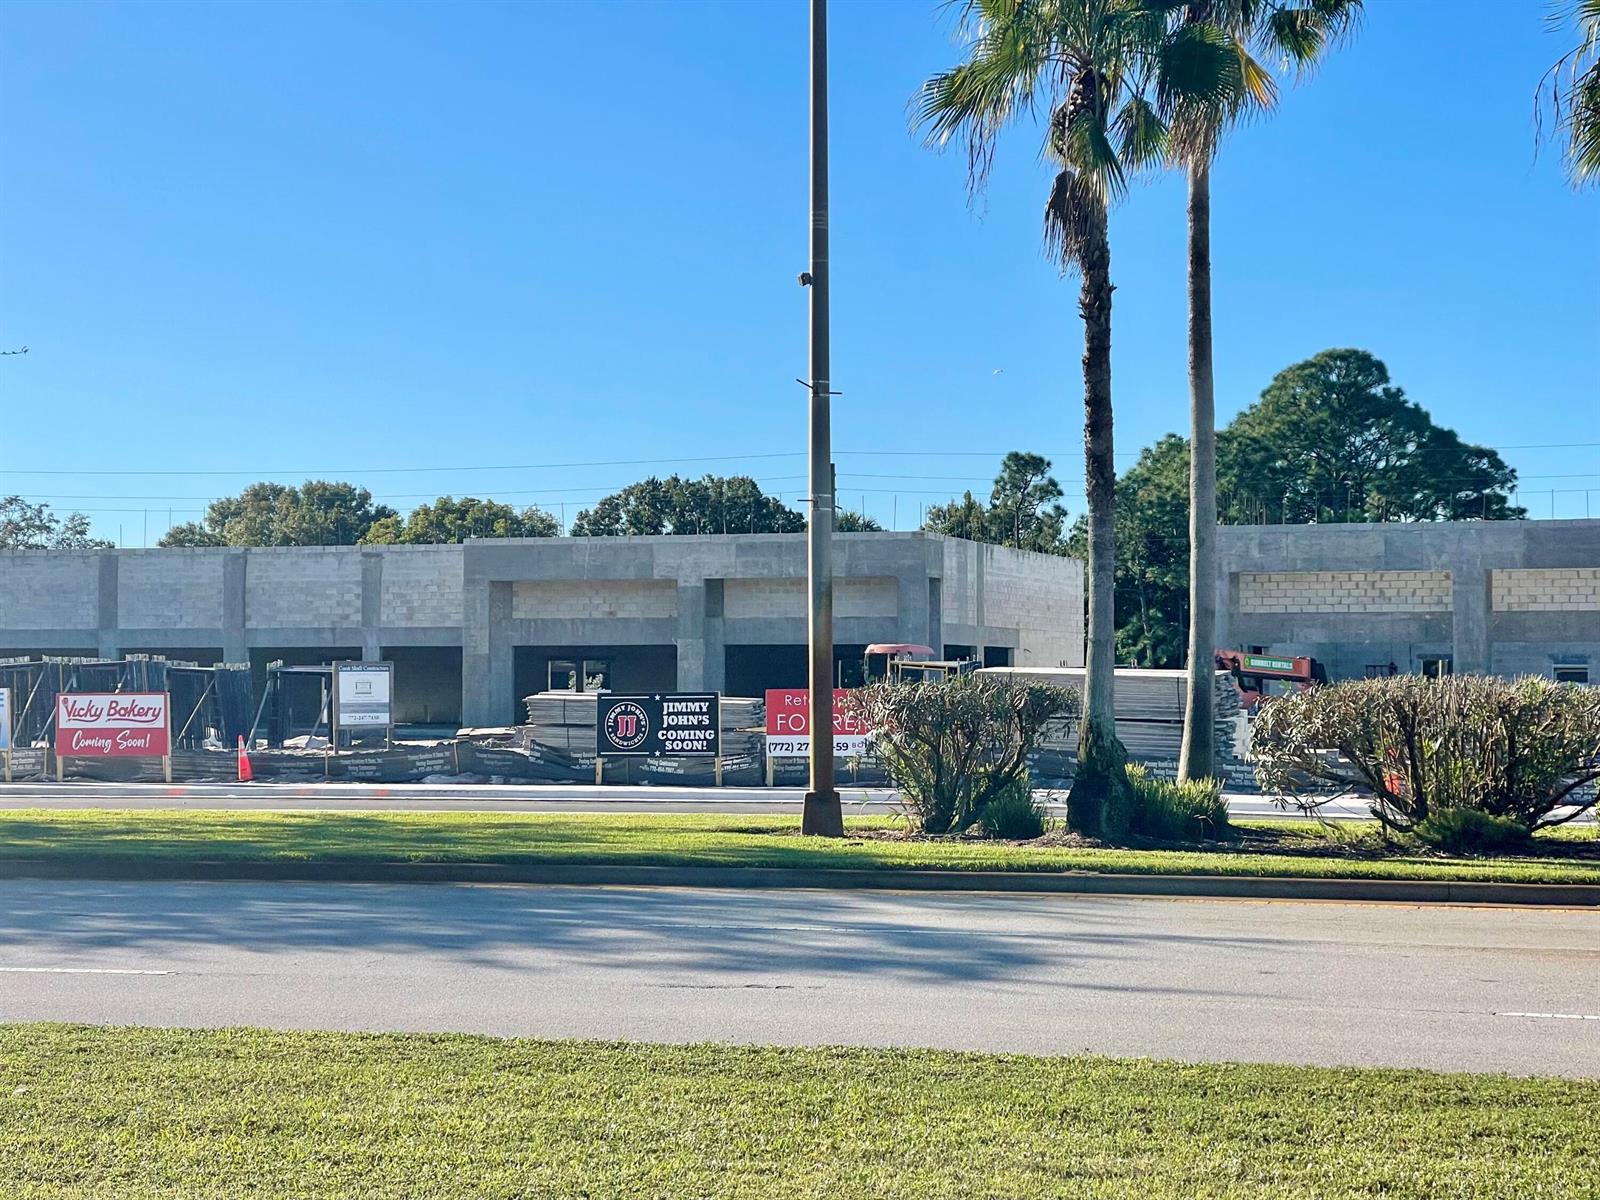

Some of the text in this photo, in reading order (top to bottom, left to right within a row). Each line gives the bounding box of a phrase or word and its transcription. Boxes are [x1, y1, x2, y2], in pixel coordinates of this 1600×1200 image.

[784, 694, 810, 706] Ret
[62, 698, 162, 723] Vicky Bakery
[663, 702, 709, 714] JIMMY
[608, 704, 647, 726] JIMMY JOHN'S
[663, 715, 710, 728] JOHN'S
[617, 715, 637, 737] JJ
[777, 713, 806, 731] FO
[72, 730, 150, 753] Coming Soon!
[657, 730, 715, 740] COMING
[665, 740, 707, 750] SOON!
[768, 742, 794, 753] (772)
